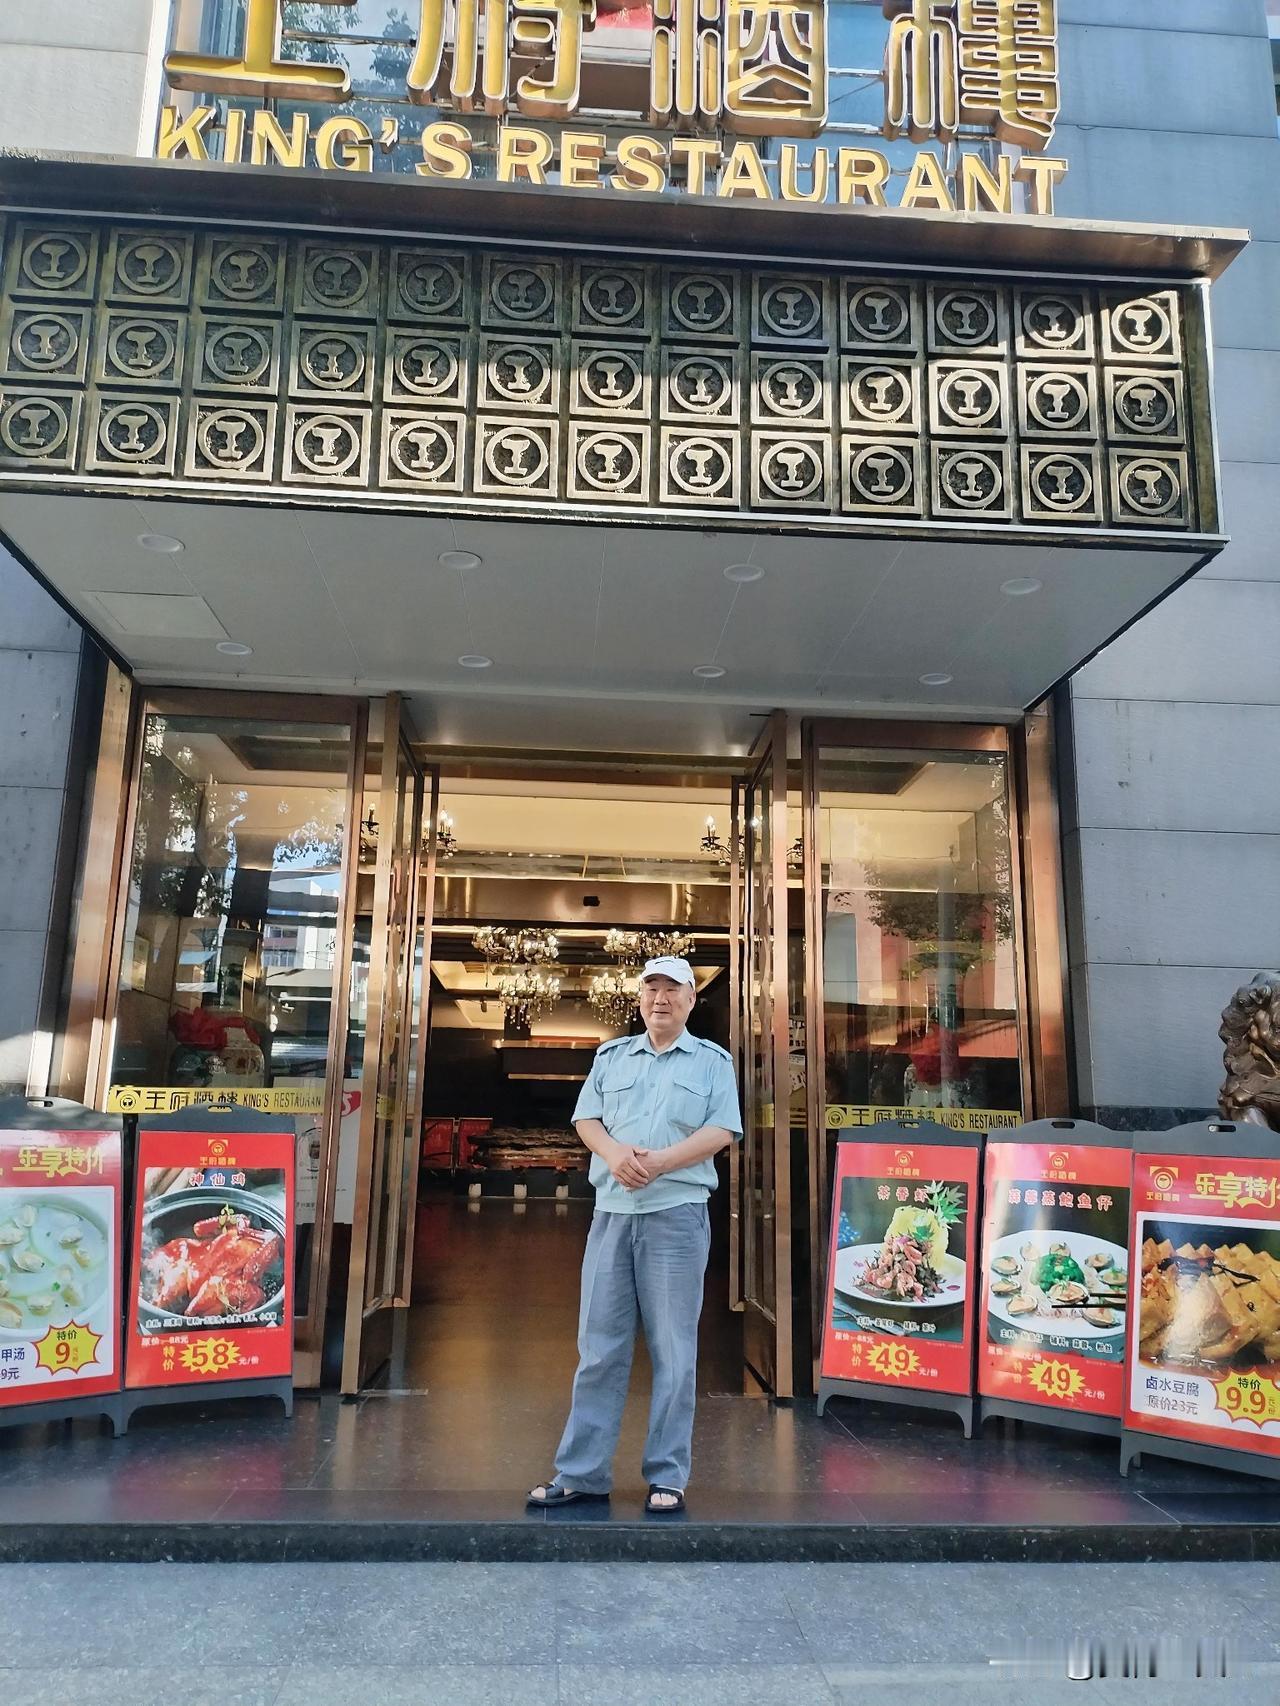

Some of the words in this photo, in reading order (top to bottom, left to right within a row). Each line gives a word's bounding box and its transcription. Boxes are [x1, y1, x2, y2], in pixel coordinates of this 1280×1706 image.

[156, 104, 474, 181] KING'S
[496, 125, 1069, 217] RESTAURANT
[969, 1113, 1017, 1130] RESTAURANT
[56, 1329, 78, 1341] 特价
[191, 1343, 230, 1367] 58
[875, 1347, 911, 1372] 49
[1040, 1366, 1071, 1392] 49
[1145, 1376, 1200, 1398] 卤水豆腐
[1237, 1377, 1261, 1391] 特价
[1147, 1394, 1199, 1416] 原价23元
[1226, 1386, 1266, 1415] 9.9
